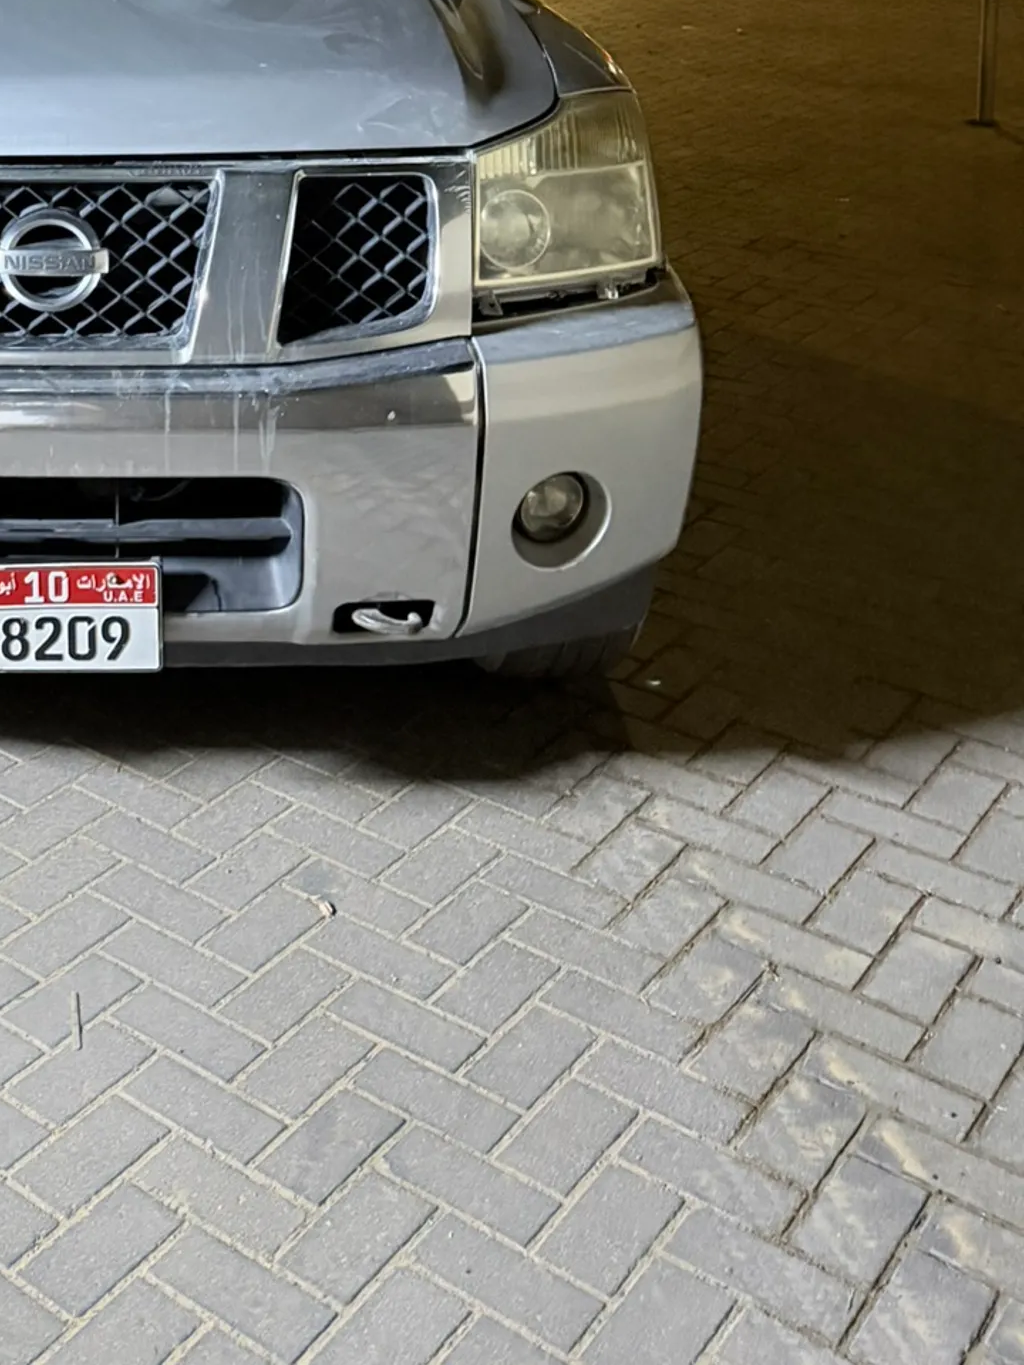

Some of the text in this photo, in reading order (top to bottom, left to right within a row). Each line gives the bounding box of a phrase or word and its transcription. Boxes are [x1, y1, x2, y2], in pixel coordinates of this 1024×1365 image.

[4, 254, 96, 271] NISSAN
[24, 571, 70, 603] 10
[103, 590, 144, 603] U.A.E
